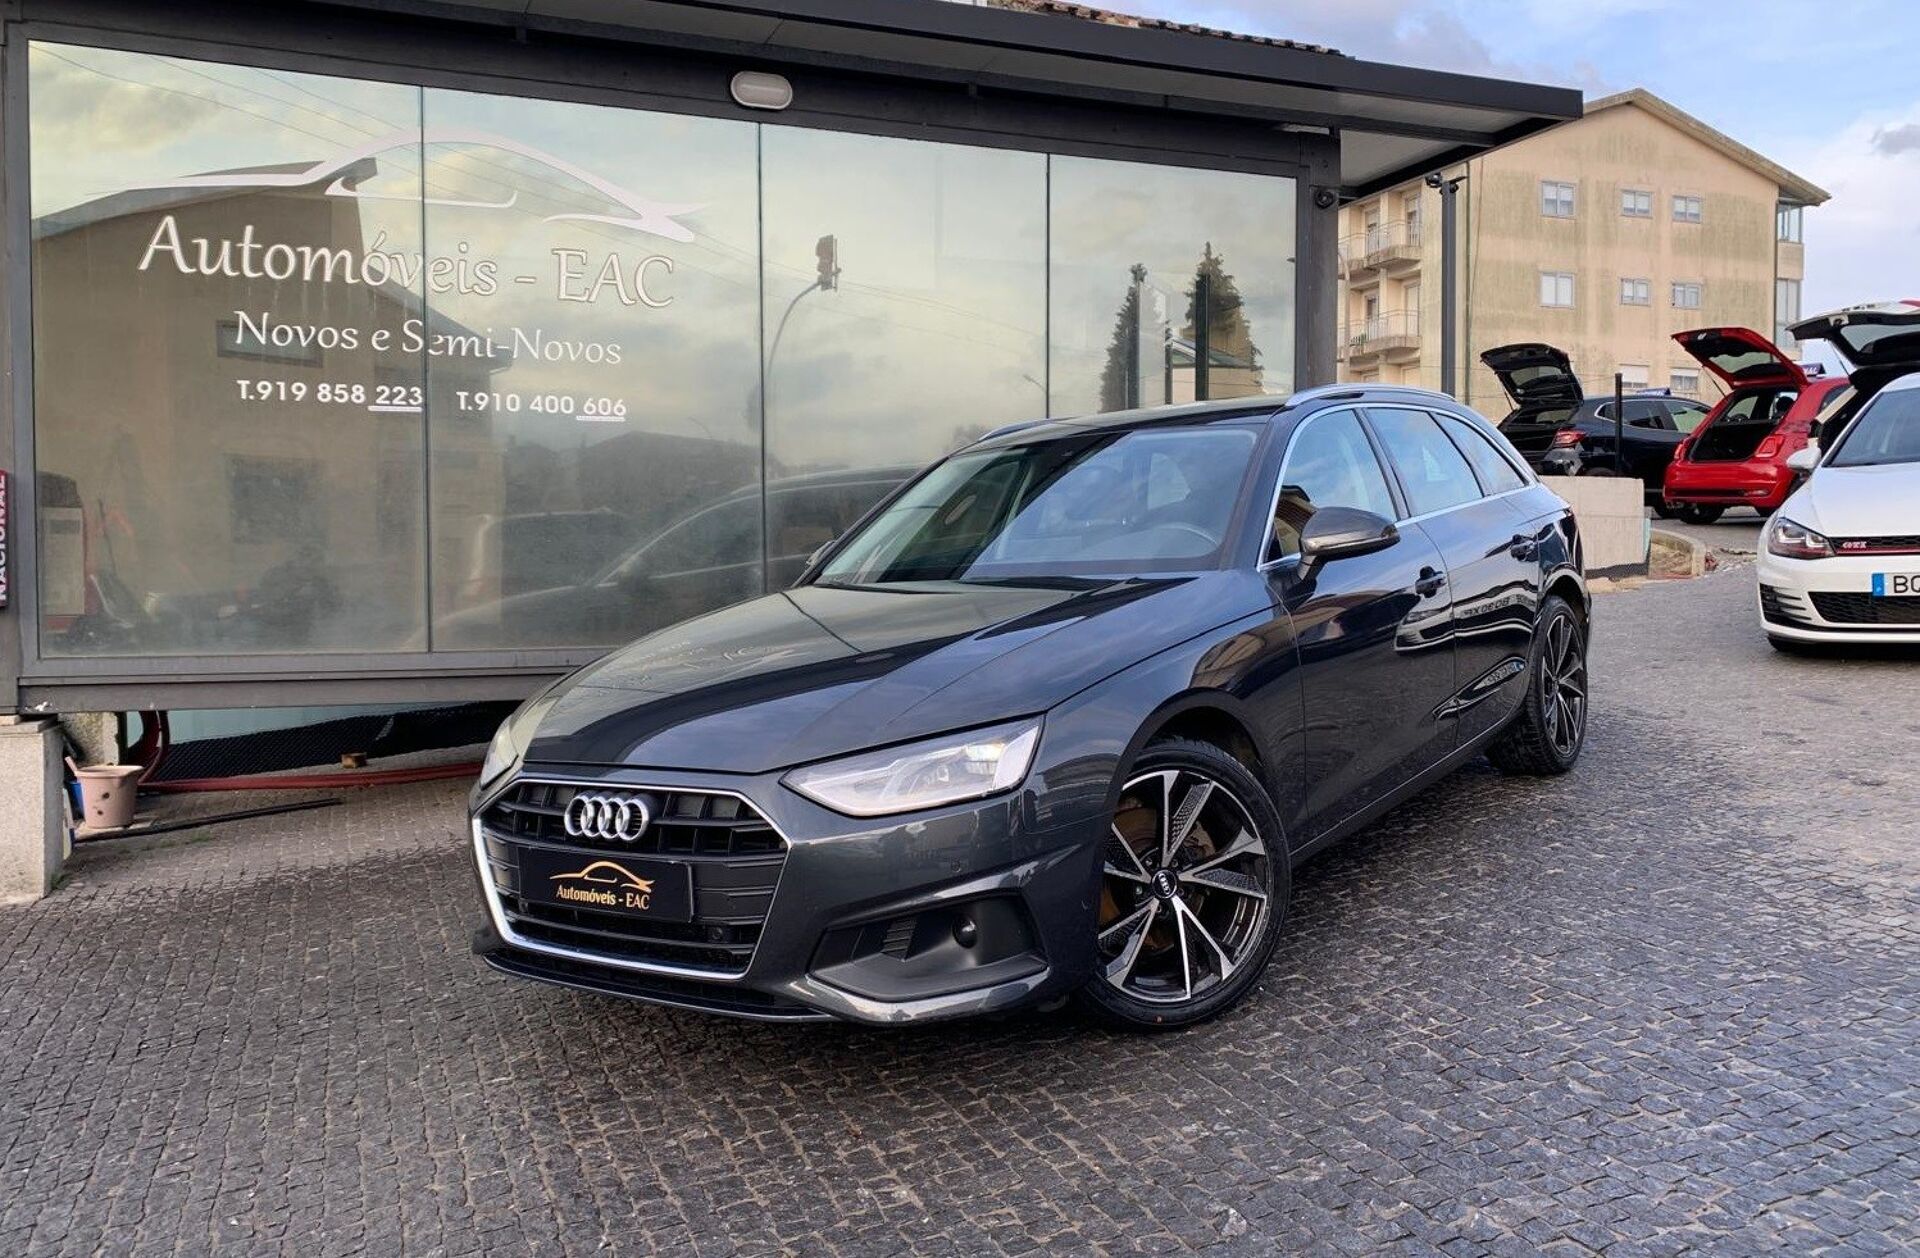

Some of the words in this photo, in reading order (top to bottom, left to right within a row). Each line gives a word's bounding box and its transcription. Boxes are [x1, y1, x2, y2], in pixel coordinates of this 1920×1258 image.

[138, 215, 498, 297] Automóveis
[551, 247, 675, 308] EAC
[233, 310, 359, 350] Novos
[371, 329, 391, 351] e
[402, 319, 622, 365] Semi-Novos
[237, 380, 307, 401] T.919
[317, 383, 365, 403] 858
[375, 386, 423, 406] 223
[456, 391, 521, 412] T.910
[530, 395, 574, 414] 400
[583, 398, 627, 417] 606
[555, 884, 616, 905] Automóveis
[626, 893, 650, 910] EAC
